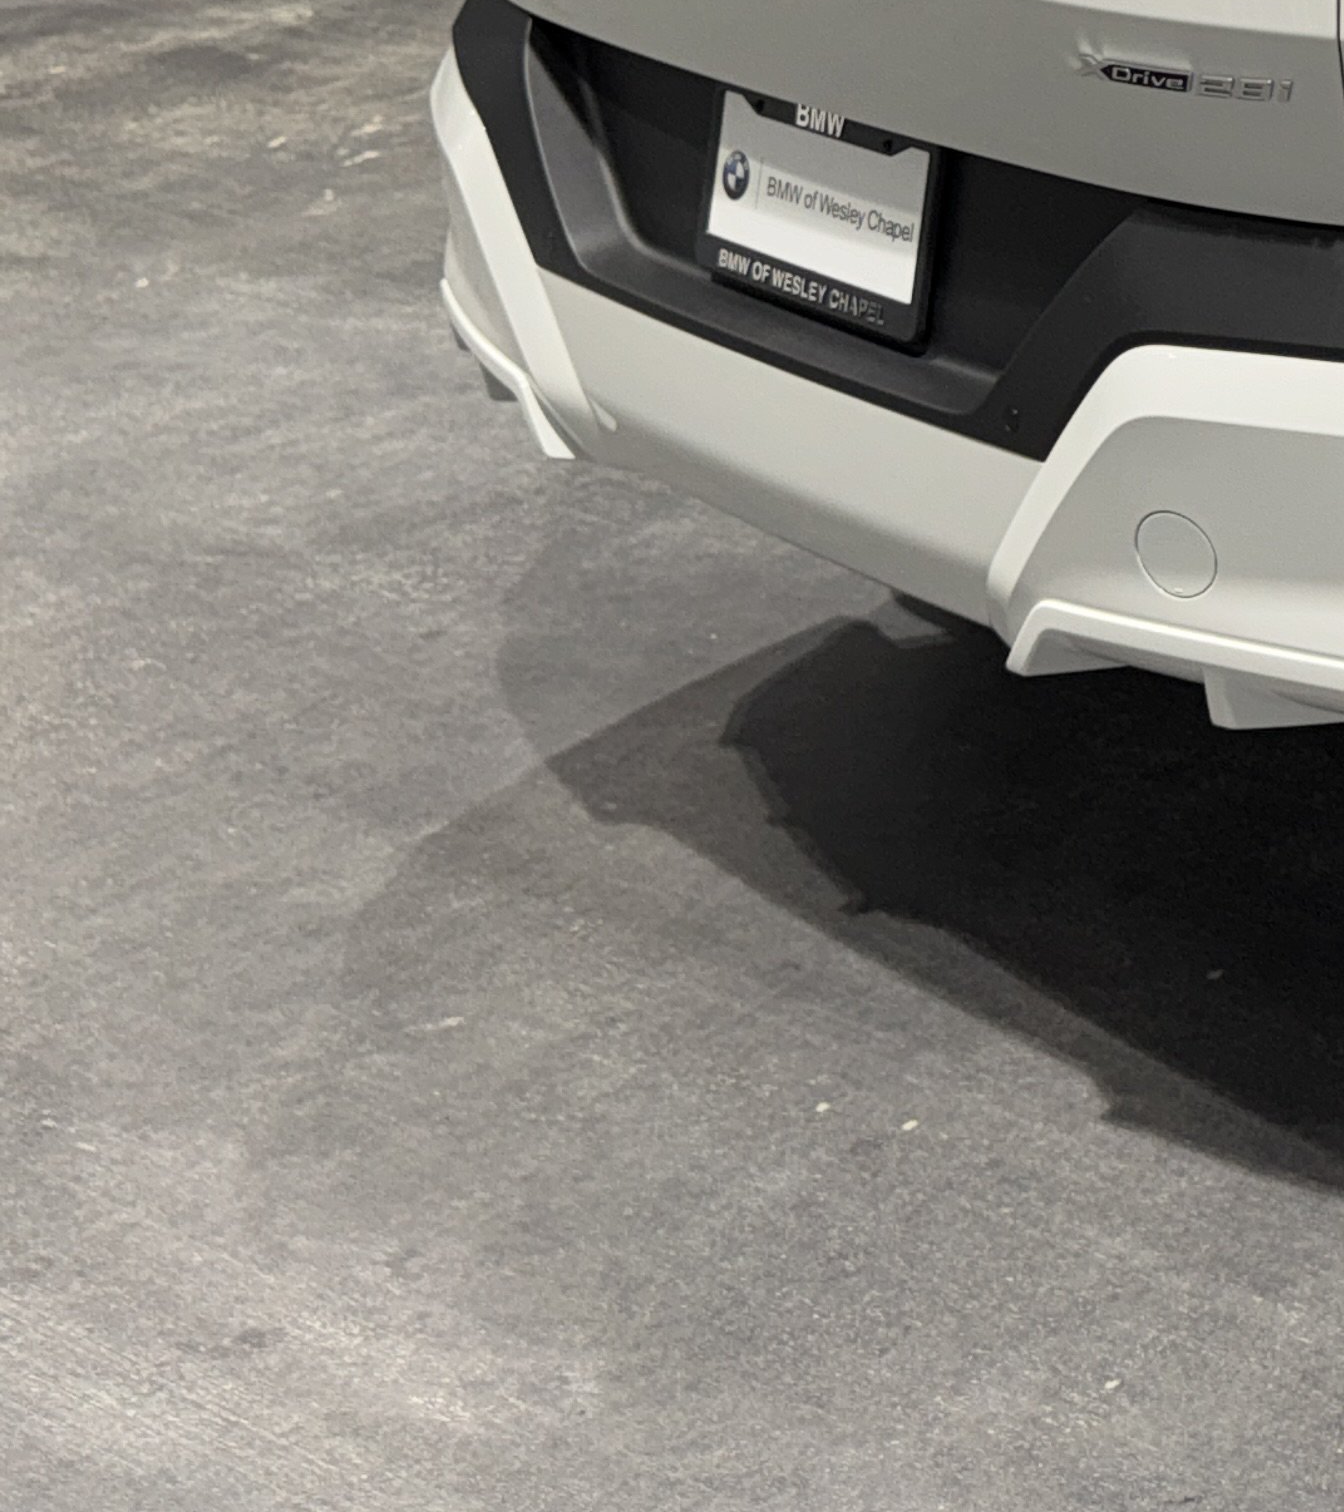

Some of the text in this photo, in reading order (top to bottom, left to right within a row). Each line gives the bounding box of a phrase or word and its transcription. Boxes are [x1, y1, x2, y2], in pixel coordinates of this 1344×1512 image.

[795, 103, 845, 138] BMW
[766, 176, 915, 243] BMW of Wesley Chapel
[718, 249, 885, 325] BMW OF WESLEY CHAPEL
